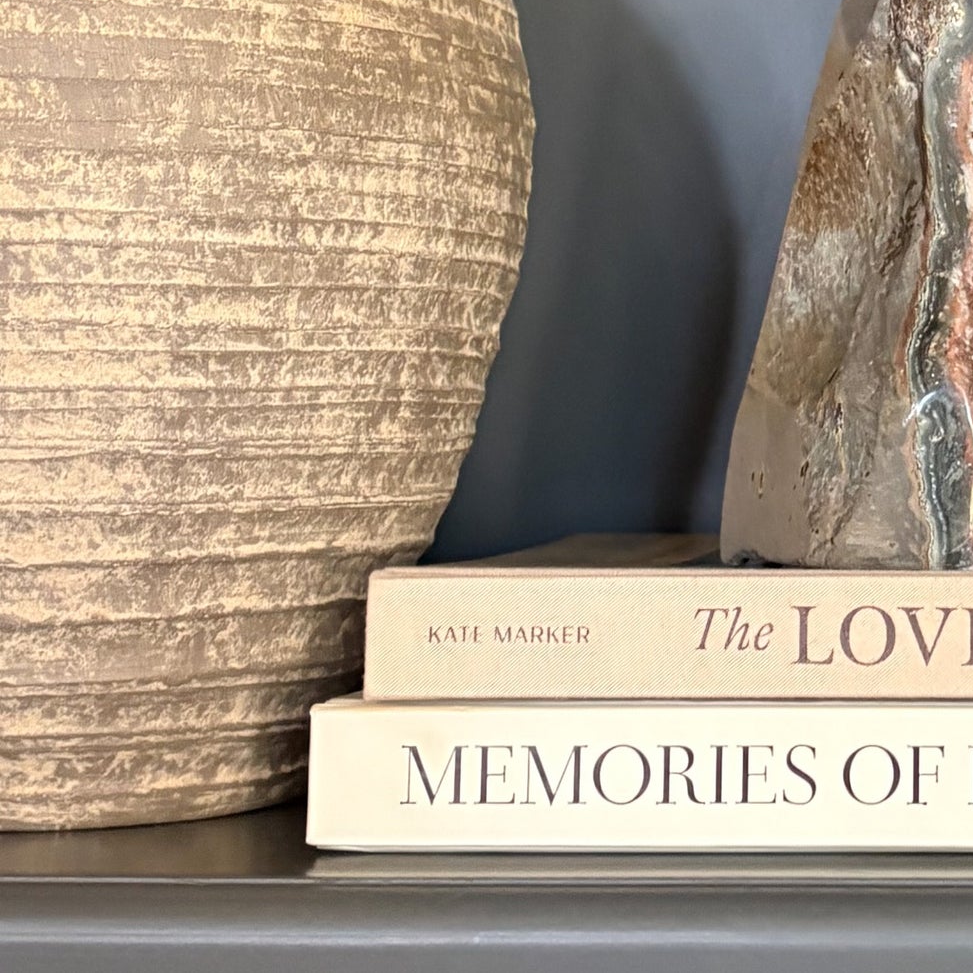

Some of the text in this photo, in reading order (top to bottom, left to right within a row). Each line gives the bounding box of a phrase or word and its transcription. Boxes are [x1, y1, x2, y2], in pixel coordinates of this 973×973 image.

[427, 625, 590, 645] KATE MARKER
[693, 606, 775, 652] The
[399, 744, 817, 806] MEMORIES
[842, 744, 945, 806] OF
